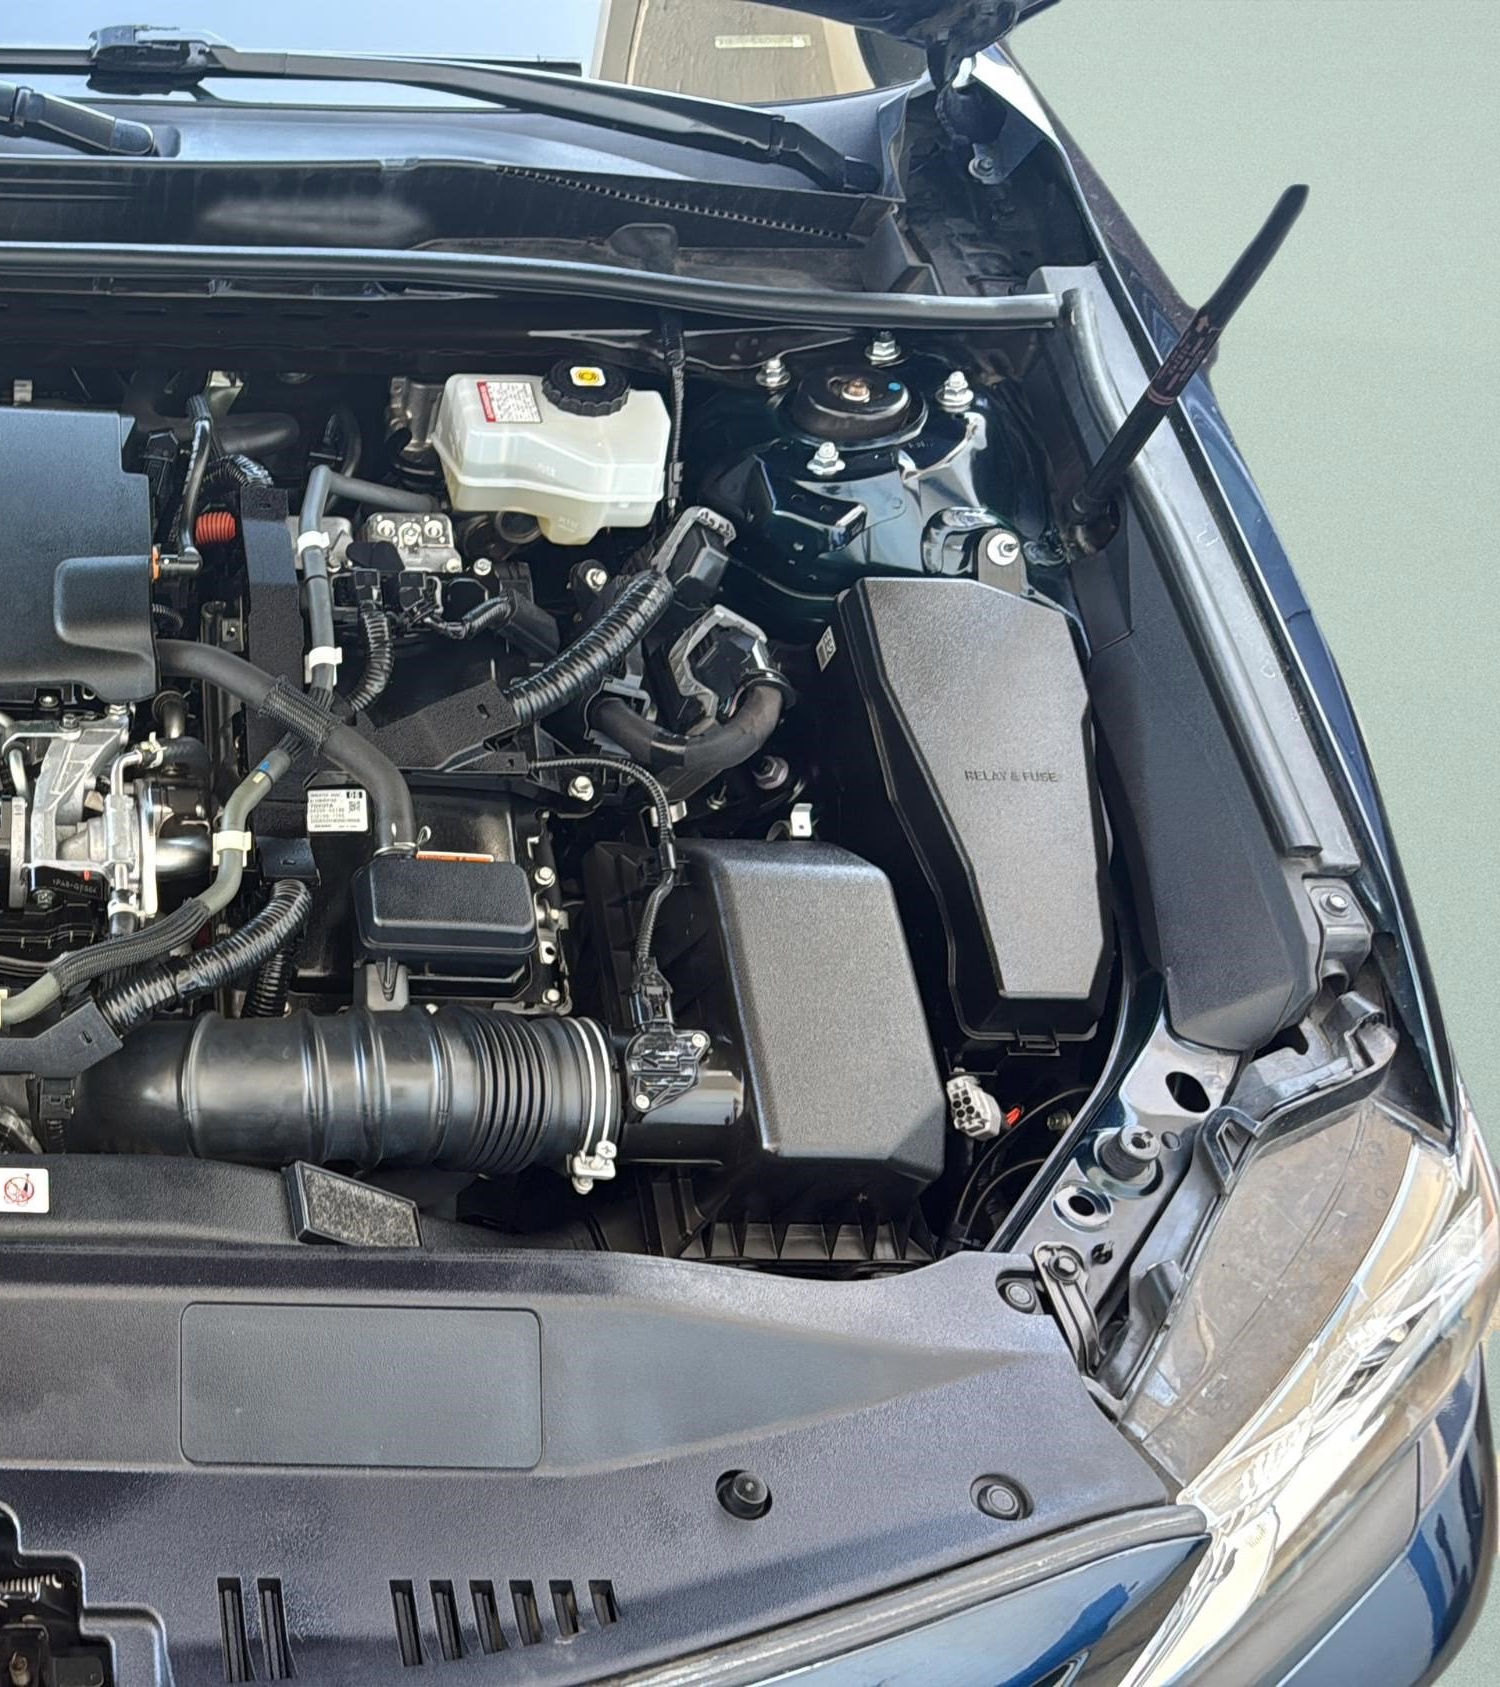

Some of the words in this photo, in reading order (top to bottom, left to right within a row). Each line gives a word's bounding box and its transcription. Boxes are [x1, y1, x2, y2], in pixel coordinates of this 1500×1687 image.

[964, 769, 1007, 782] RELAY
[1010, 771, 1020, 782] &
[1022, 771, 1060, 783] FUSE
